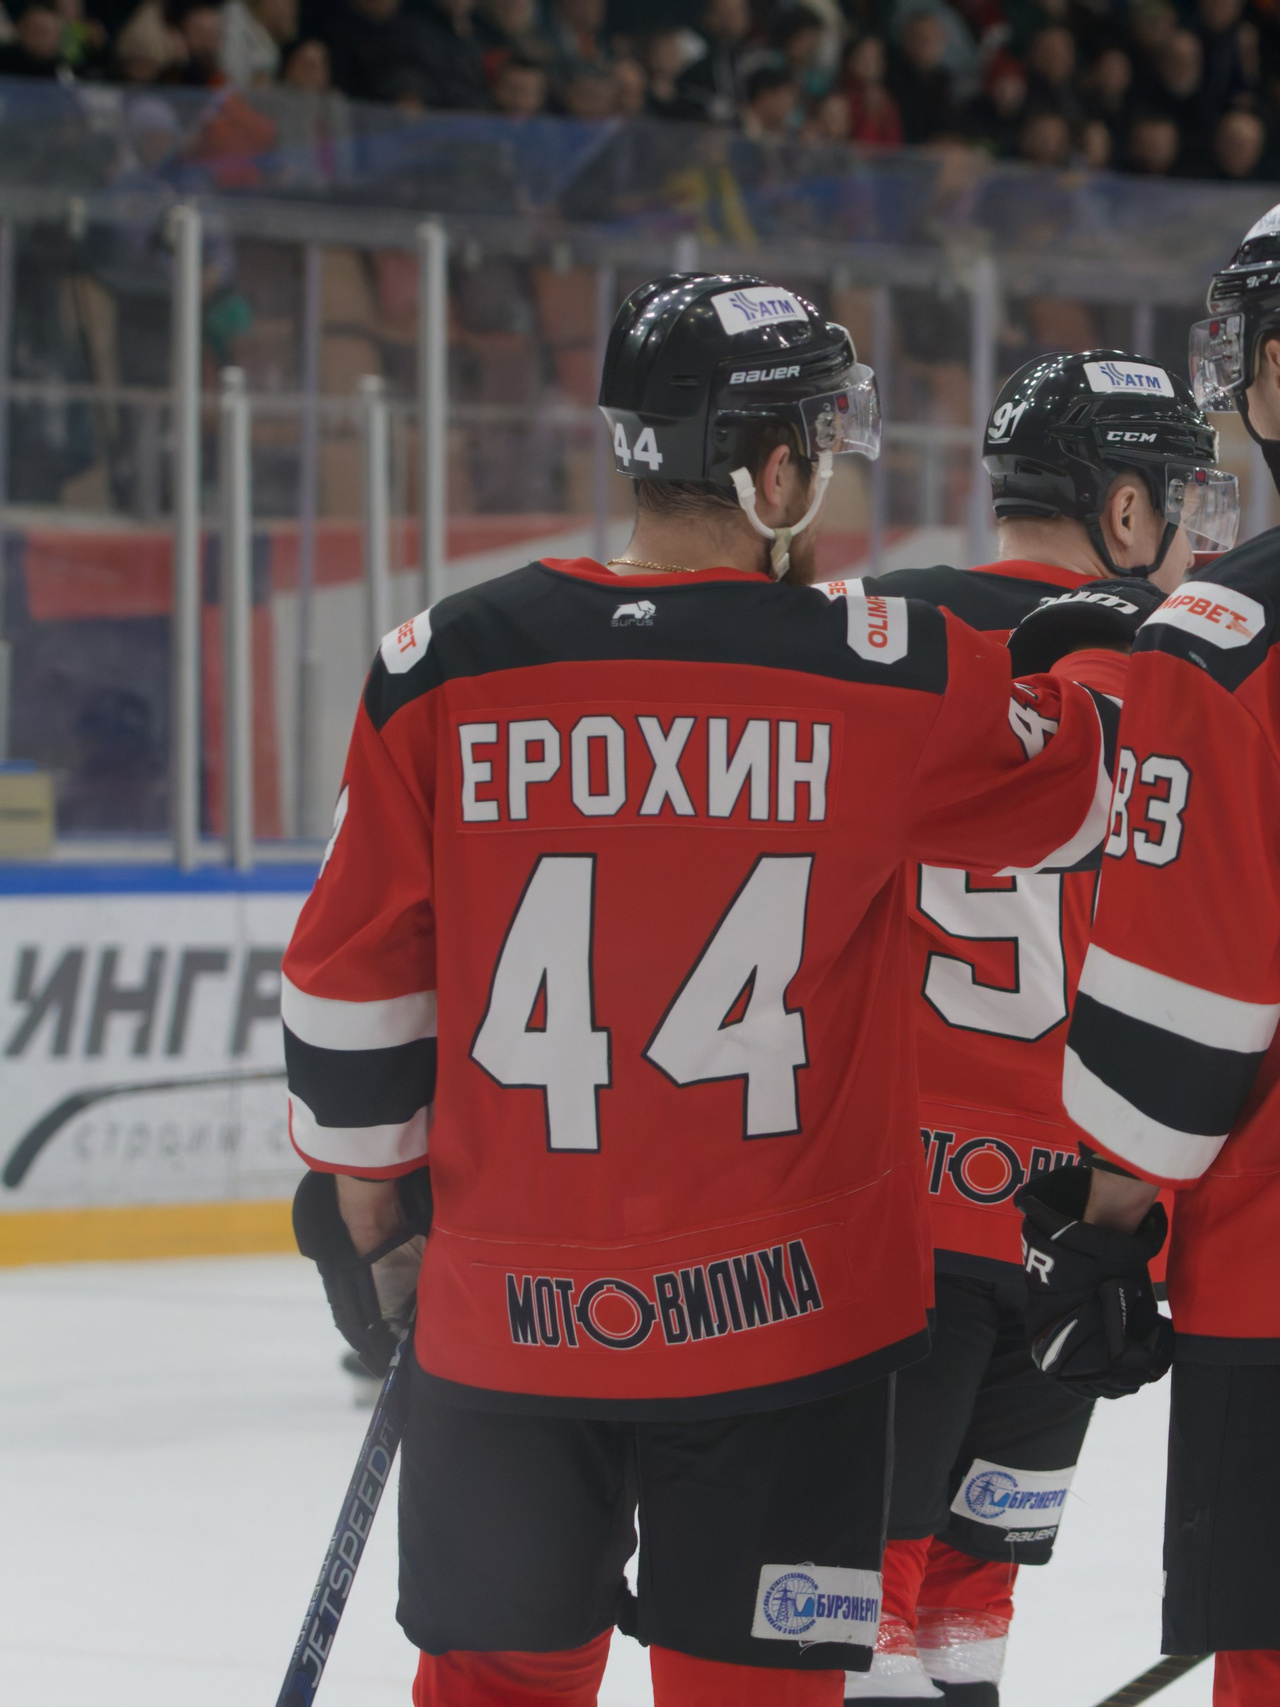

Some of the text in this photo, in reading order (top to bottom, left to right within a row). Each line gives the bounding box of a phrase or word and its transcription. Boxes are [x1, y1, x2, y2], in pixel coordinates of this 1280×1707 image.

[729, 366, 800, 384] BAUER
[613, 423, 663, 471] 44
[988, 401, 1028, 444] 91
[1107, 431, 1158, 443] CCM
[457, 713, 833, 823] ЕРОХИН
[917, 861, 1071, 1044] 9
[468, 852, 816, 1154] 44
[505, 1238, 823, 1351] МОТОВИЛИХА
[302, 1444, 391, 1689] JETSPEED
[1005, 1526, 1057, 1542] BAUER
